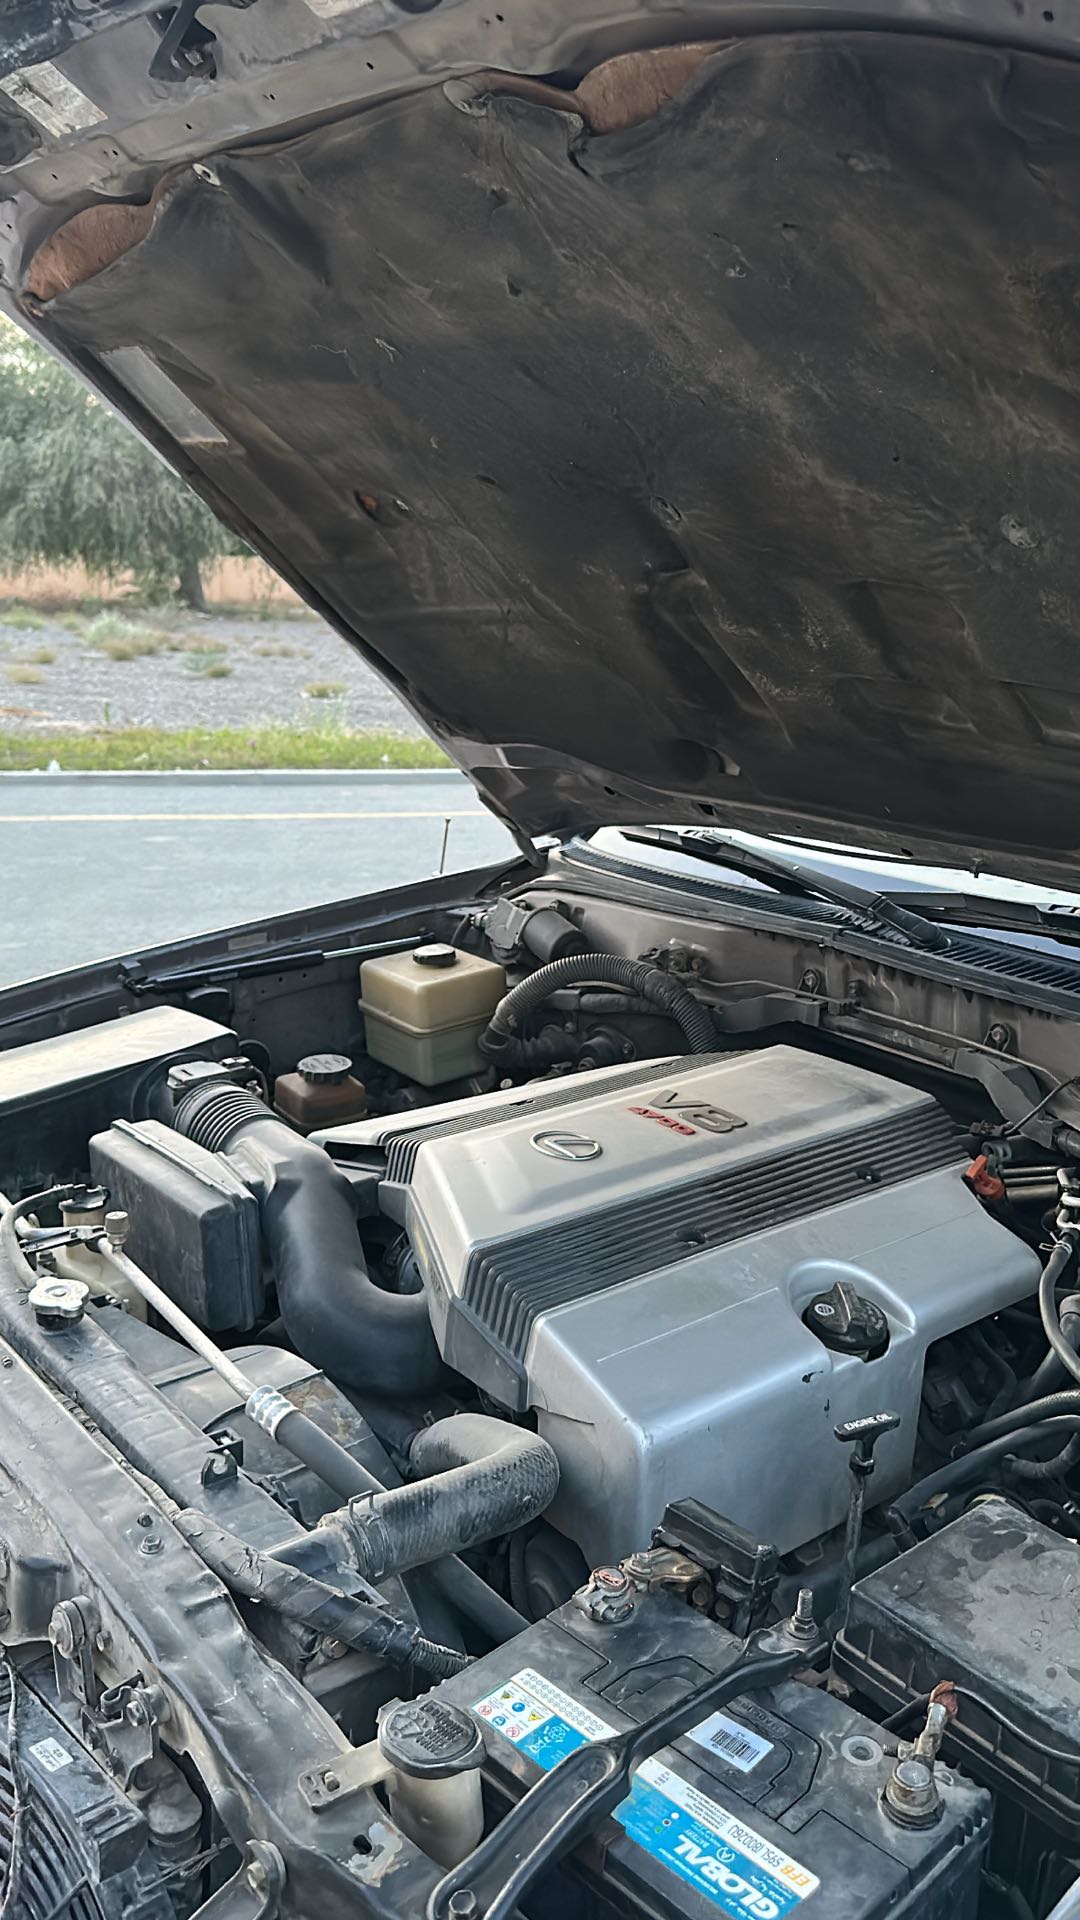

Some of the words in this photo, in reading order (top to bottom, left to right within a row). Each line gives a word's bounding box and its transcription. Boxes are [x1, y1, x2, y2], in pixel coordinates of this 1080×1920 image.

[626, 1106, 696, 1136] 4700
[649, 1089, 748, 1134] V8
[844, 1415, 878, 1431] ENGINE
[877, 1413, 893, 1423] OIL
[684, 1829, 710, 1848] BATTERY
[672, 1834, 779, 1919] GLOBAL
[780, 1864, 813, 1887] EFB
